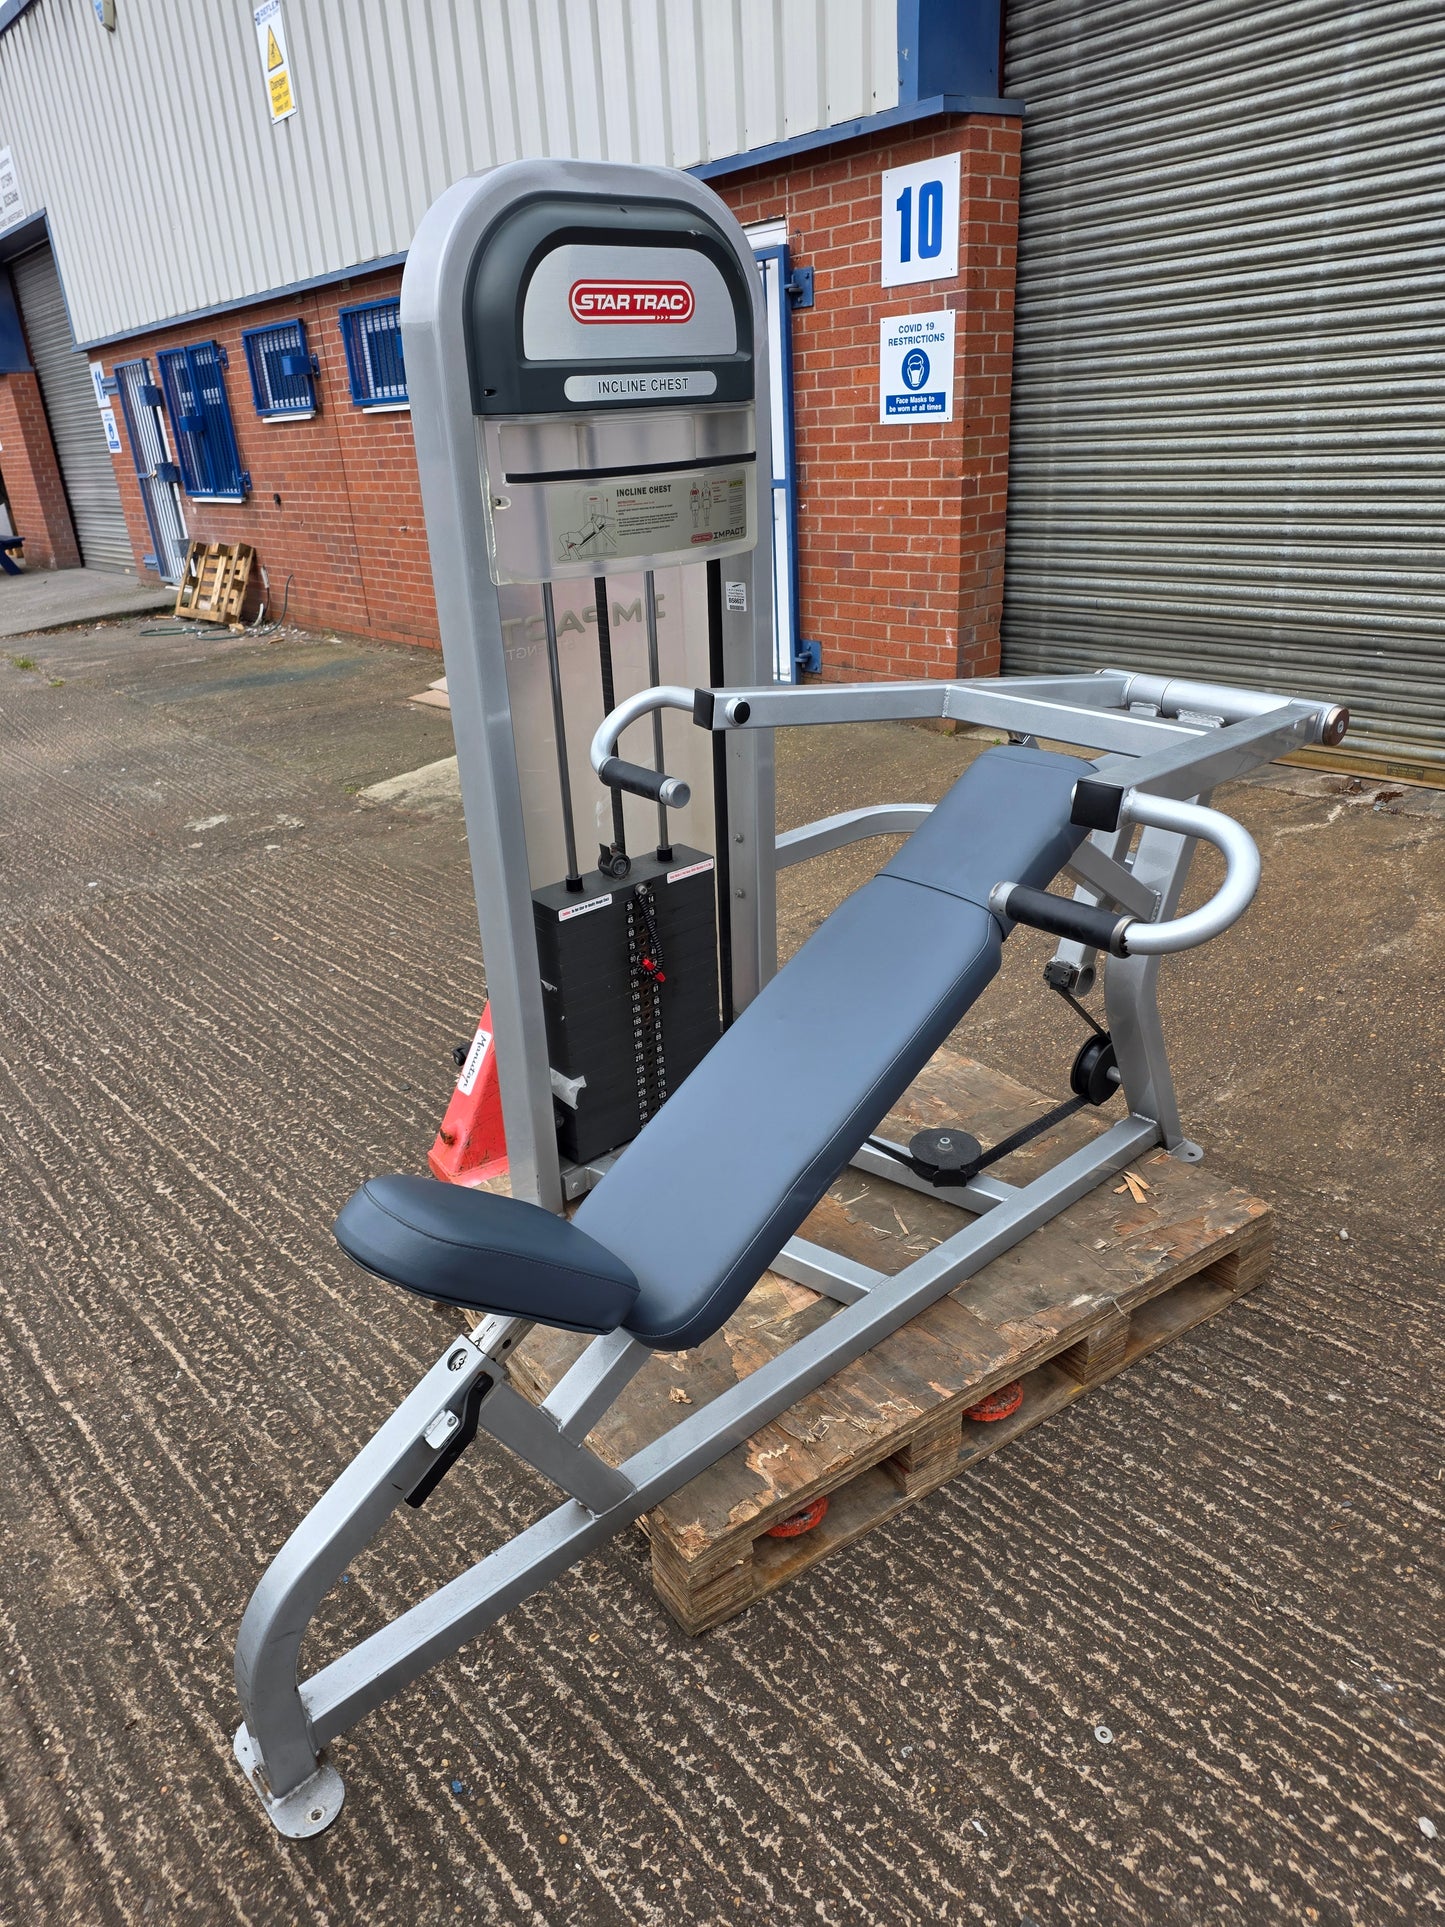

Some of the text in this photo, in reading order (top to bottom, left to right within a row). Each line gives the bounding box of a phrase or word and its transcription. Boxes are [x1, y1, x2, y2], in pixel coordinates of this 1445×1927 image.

[896, 180, 943, 263] 10
[576, 294, 684, 310] STAR TRAC
[898, 321, 935, 334] COVID 19
[888, 332, 945, 347] RESTRICTIONS
[598, 378, 689, 394] INCLINE CHEST
[895, 395, 936, 405] Face Masks to
[888, 403, 942, 413] be worn at all times
[616, 484, 672, 498] INCLINE CHEST
[713, 526, 745, 540] IMPACT
[627, 903, 633, 911] 30
[631, 981, 639, 989] 120
[632, 993, 640, 1001] 135
[462, 1034, 487, 1088] Manutan
[636, 1054, 644, 1063] 210
[638, 1078, 646, 1086] 240
